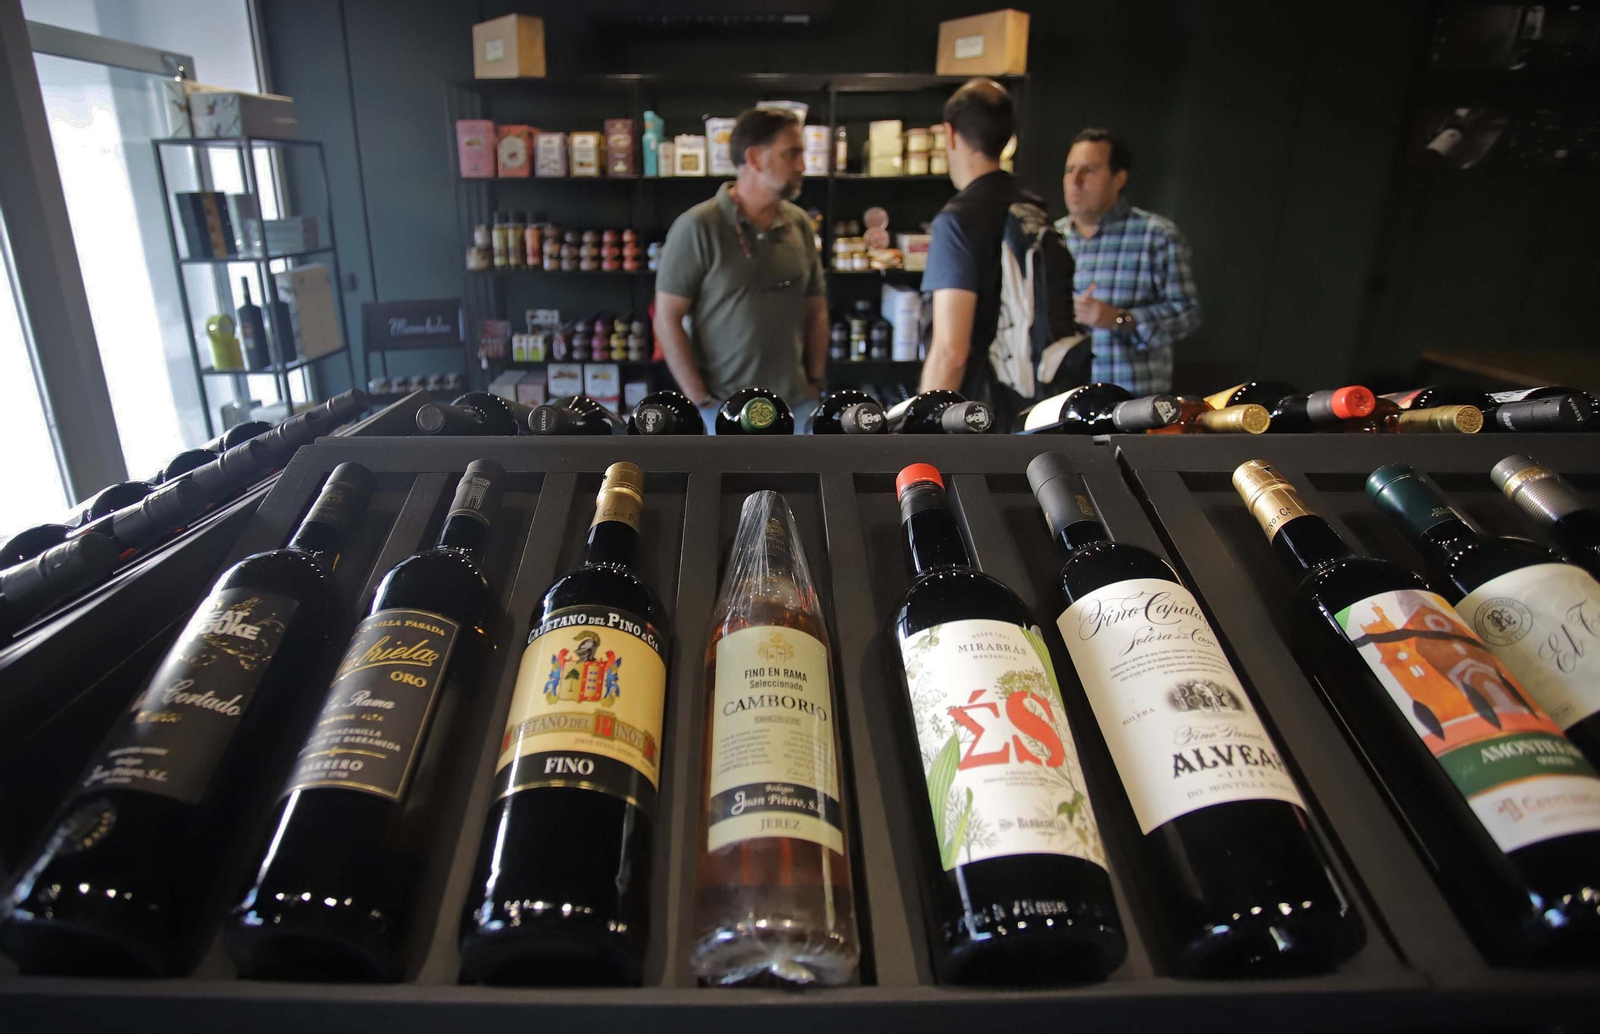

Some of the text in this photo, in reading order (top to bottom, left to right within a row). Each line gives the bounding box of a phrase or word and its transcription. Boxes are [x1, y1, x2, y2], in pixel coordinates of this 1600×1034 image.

[1079, 592, 1143, 641] Fino
[200, 621, 262, 641] DUKE
[403, 620, 446, 637] PASADA
[527, 613, 588, 645] CAYETANO
[588, 616, 606, 626] DEL
[607, 612, 642, 636] PINO
[957, 643, 1028, 657] MIRABRÁS
[1118, 626, 1172, 657] Solera
[1190, 628, 1217, 648] Casa
[389, 670, 428, 688] ORO
[744, 667, 808, 683] FINO EN RAMA
[749, 679, 804, 692] Seleccionado
[163, 678, 244, 717] Cortado
[342, 690, 396, 710] Rama
[722, 694, 828, 722] CAMBORIO
[1122, 707, 1156, 727] SOLERA
[343, 735, 401, 752] BARRAMEDA
[543, 756, 595, 776] FINO
[731, 790, 765, 816] Juan
[767, 794, 807, 809] Piñero,
[760, 818, 801, 831] JEREZ
